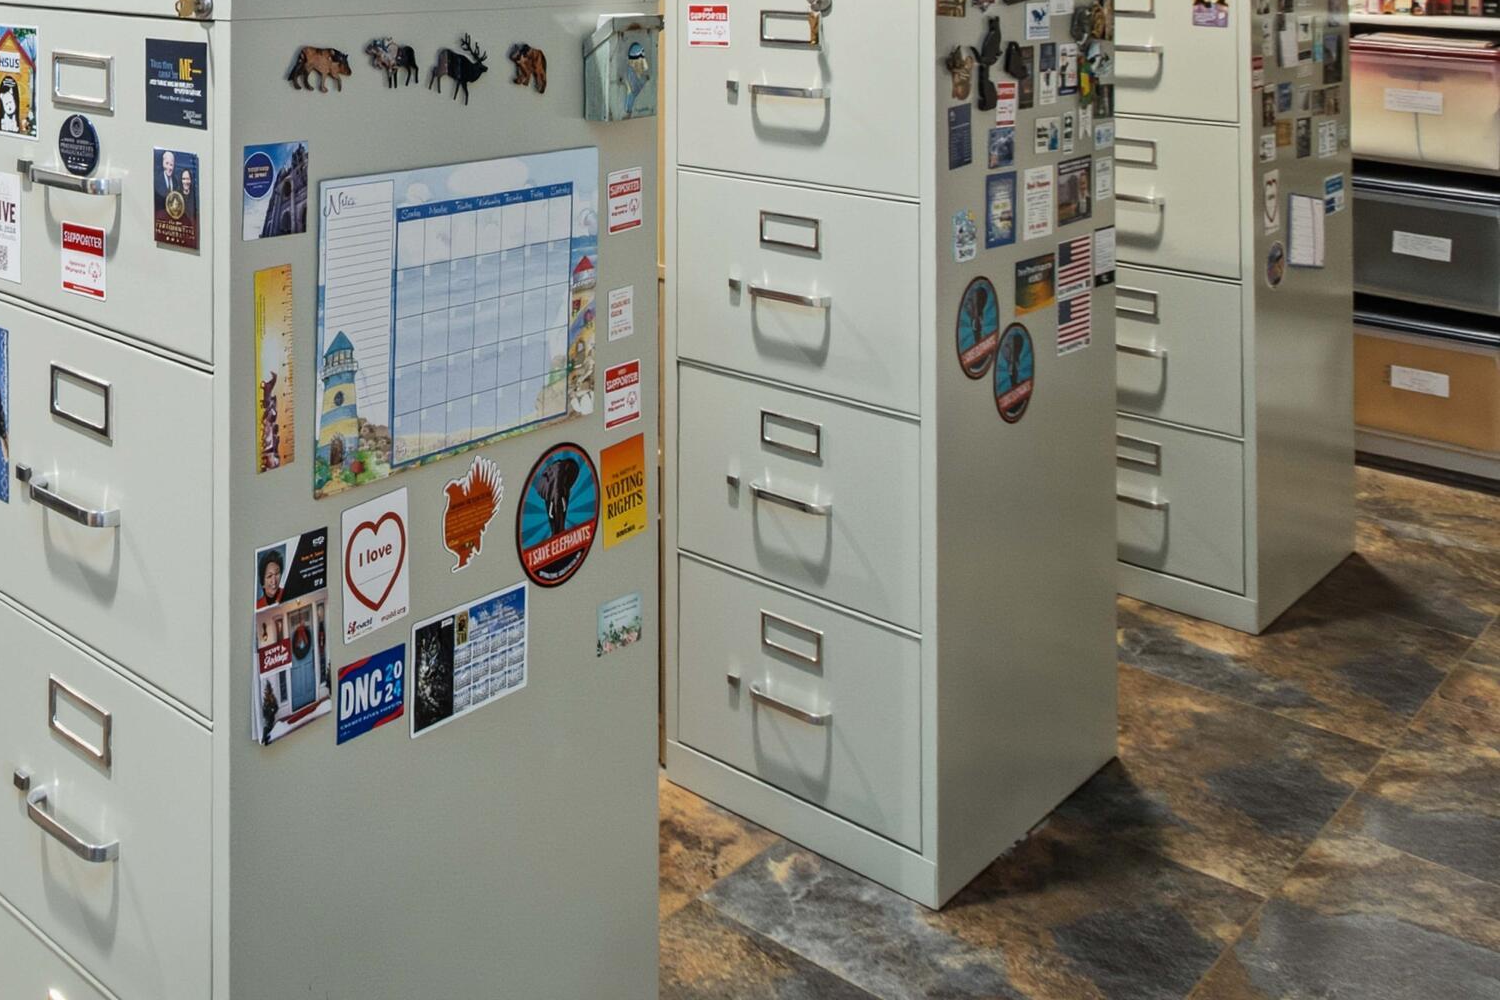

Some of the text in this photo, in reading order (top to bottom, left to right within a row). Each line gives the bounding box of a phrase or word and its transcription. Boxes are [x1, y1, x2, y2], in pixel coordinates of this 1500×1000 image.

[609, 180, 640, 197] SUPPORTER
[63, 230, 102, 249] SUPPORTER
[606, 371, 639, 393] SUPPORTER
[606, 472, 643, 499] VOTING
[607, 490, 643, 519] RIGHTS
[359, 543, 392, 567] I love
[533, 545, 550, 565] SAVE
[551, 525, 591, 556] ELEPHANTS
[340, 668, 382, 721] DNC
[385, 660, 403, 682] 20
